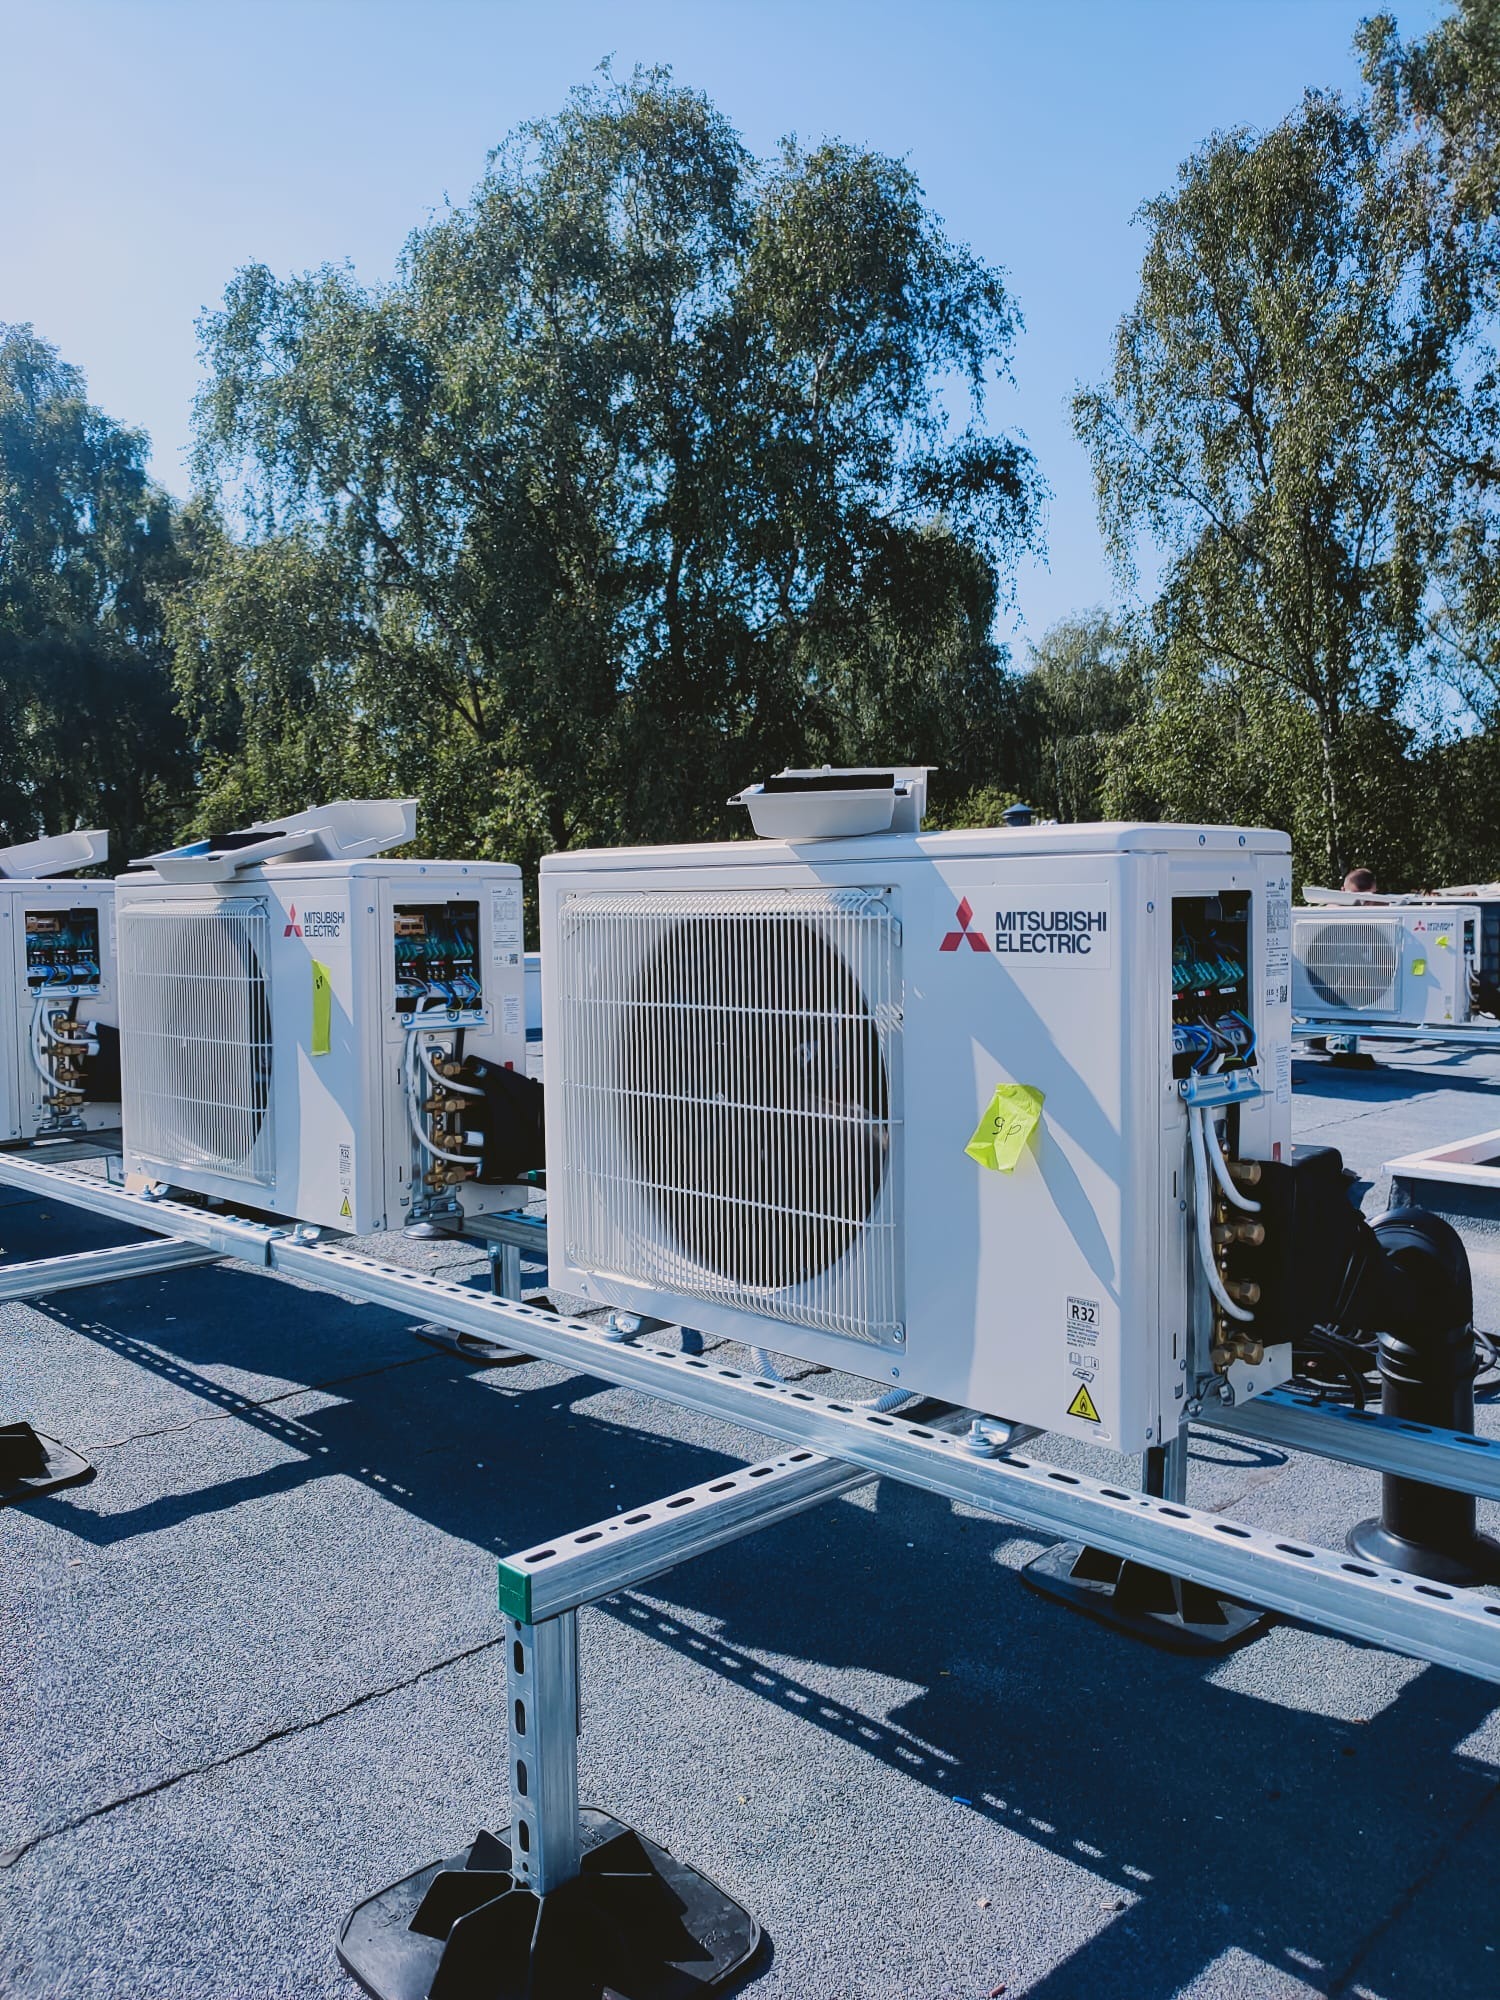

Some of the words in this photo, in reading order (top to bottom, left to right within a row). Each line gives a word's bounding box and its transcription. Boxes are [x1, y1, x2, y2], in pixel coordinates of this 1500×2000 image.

[304, 911, 345, 923] MITSUBISHI
[995, 911, 1107, 932] MITSUBISHI
[305, 925, 340, 937] ELECTRIC
[995, 933, 1091, 954] ELECTRIC
[1071, 1304, 1095, 1323] R32
